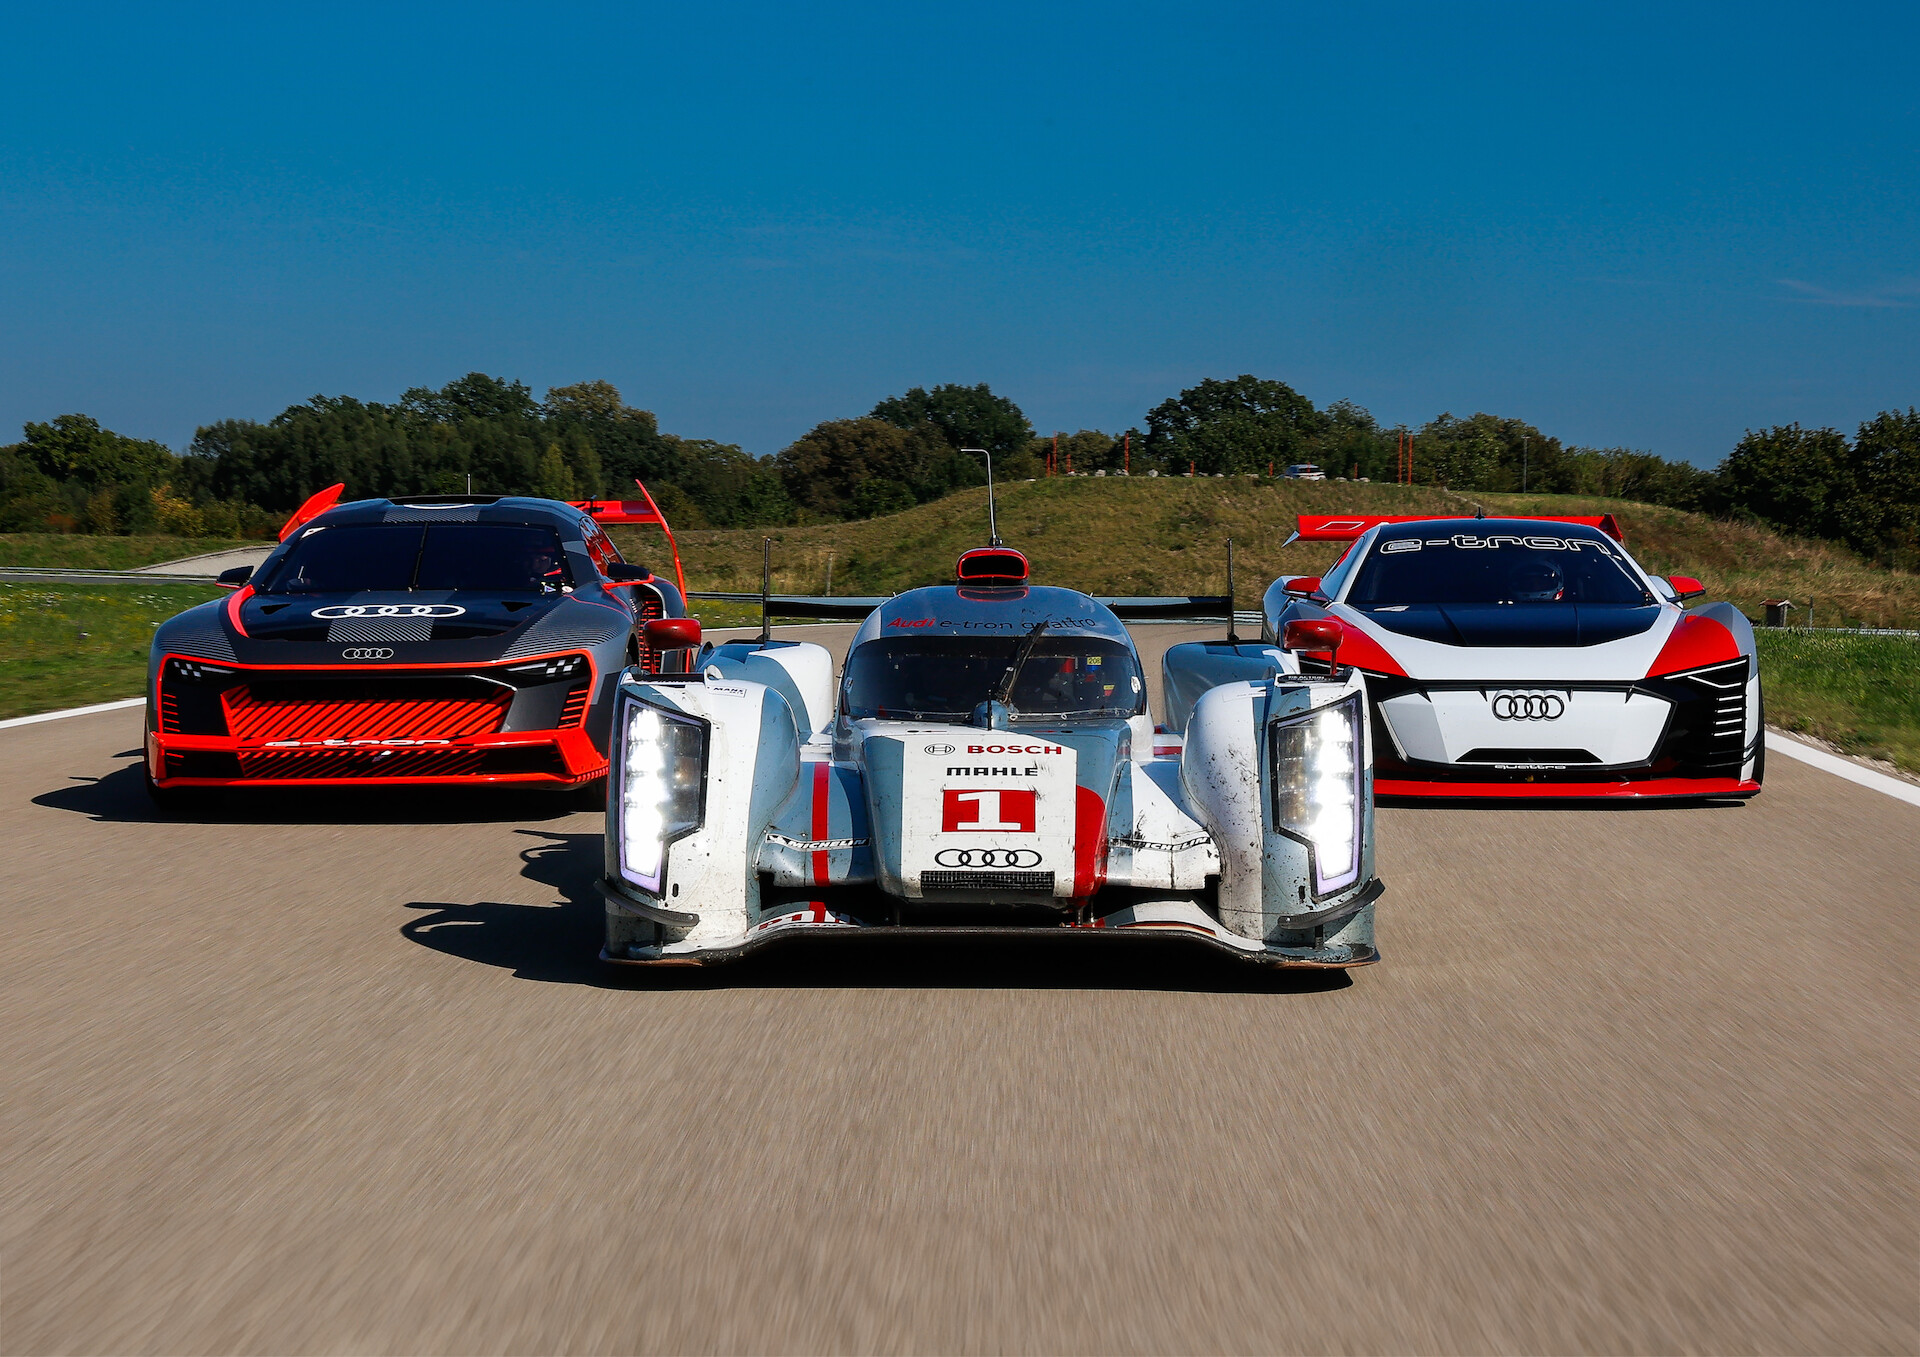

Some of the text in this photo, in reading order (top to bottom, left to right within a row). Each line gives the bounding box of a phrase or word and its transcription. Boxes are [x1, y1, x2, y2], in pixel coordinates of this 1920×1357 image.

[1380, 534, 1611, 555] e-tron
[886, 617, 936, 628] Audi
[939, 619, 1013, 630] e-tron
[967, 745, 1062, 755] BOSCH
[946, 767, 1038, 776] MAHLE
[957, 791, 1022, 831] 1
[787, 839, 867, 850] MICHELIN
